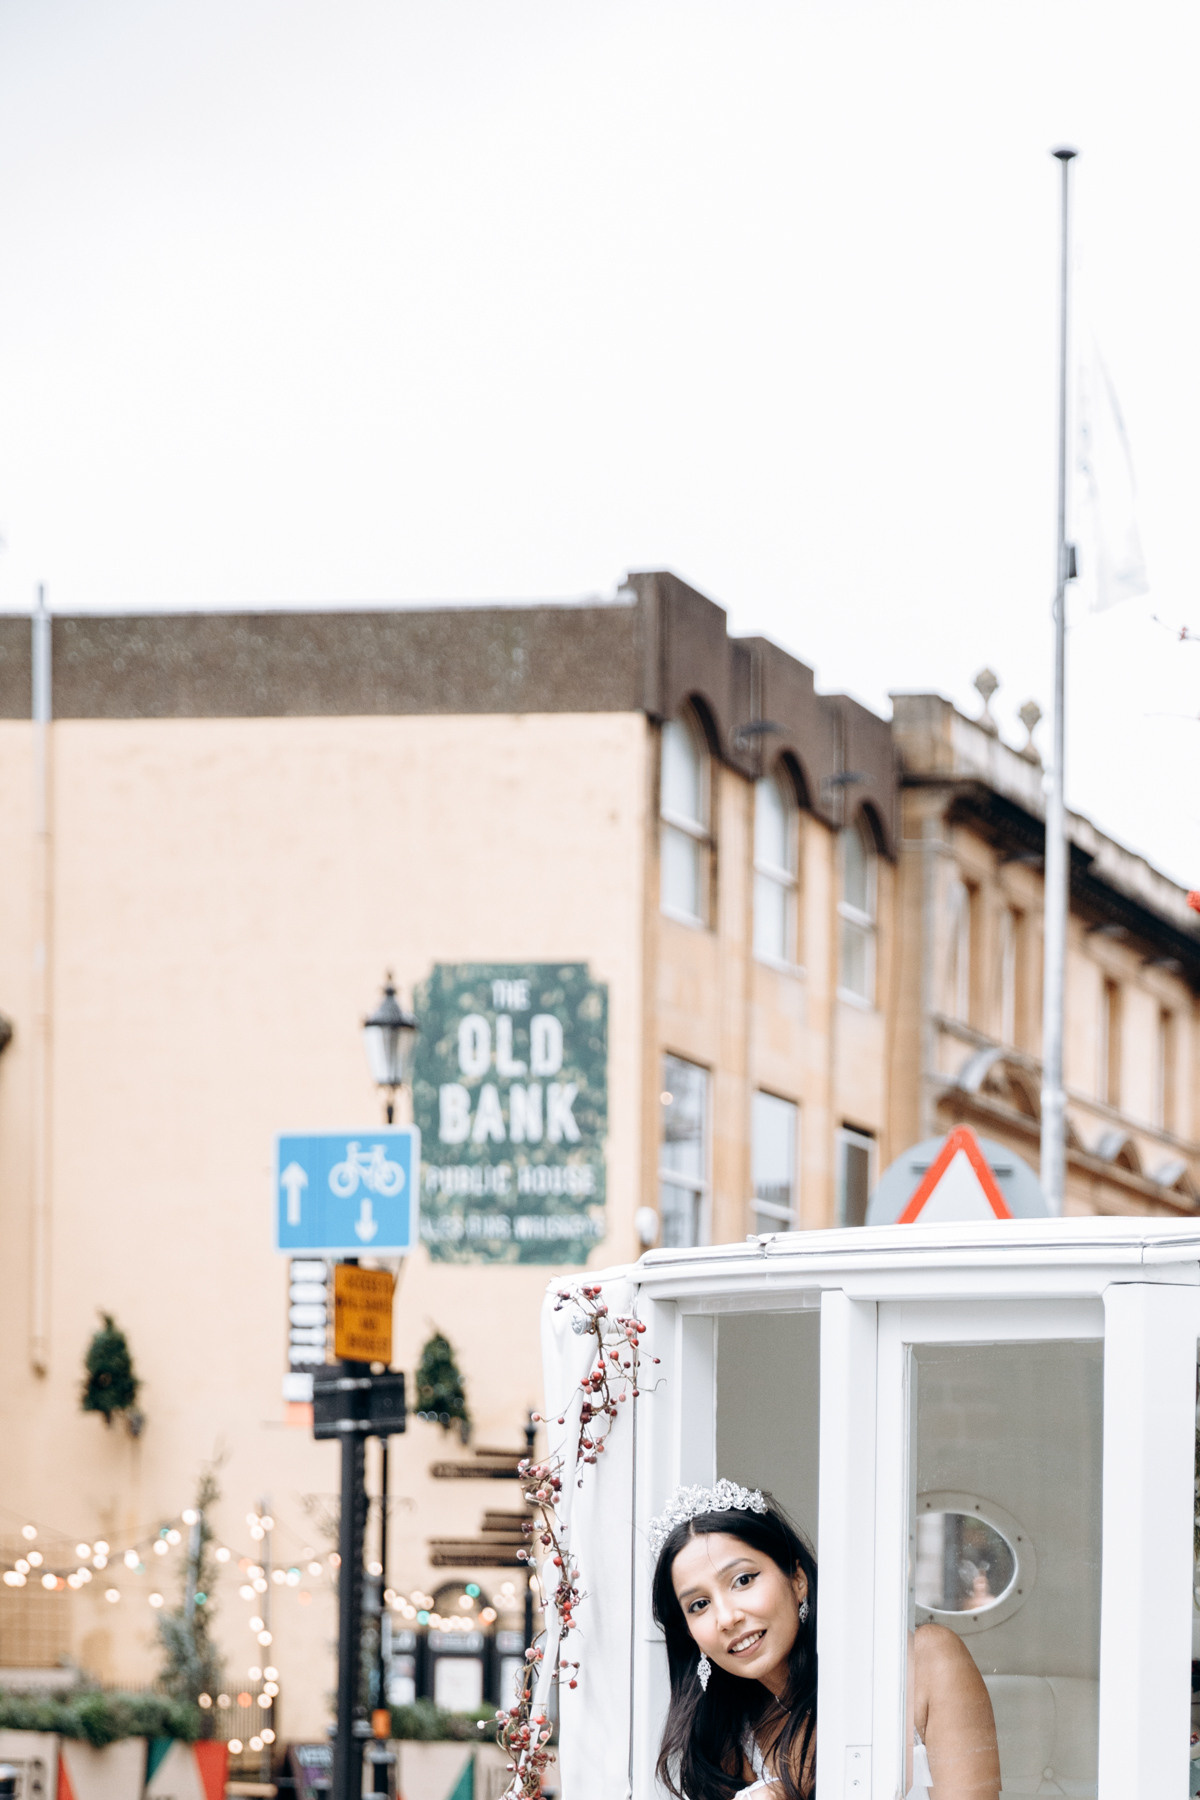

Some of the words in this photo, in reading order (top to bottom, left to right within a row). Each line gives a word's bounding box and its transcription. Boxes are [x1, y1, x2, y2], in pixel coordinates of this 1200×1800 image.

[491, 979, 531, 1010] THE
[458, 1013, 564, 1077] OLD
[438, 1082, 582, 1144] BANK
[426, 1165, 512, 1197] PUBLIC
[517, 1164, 597, 1196] HOUSE
